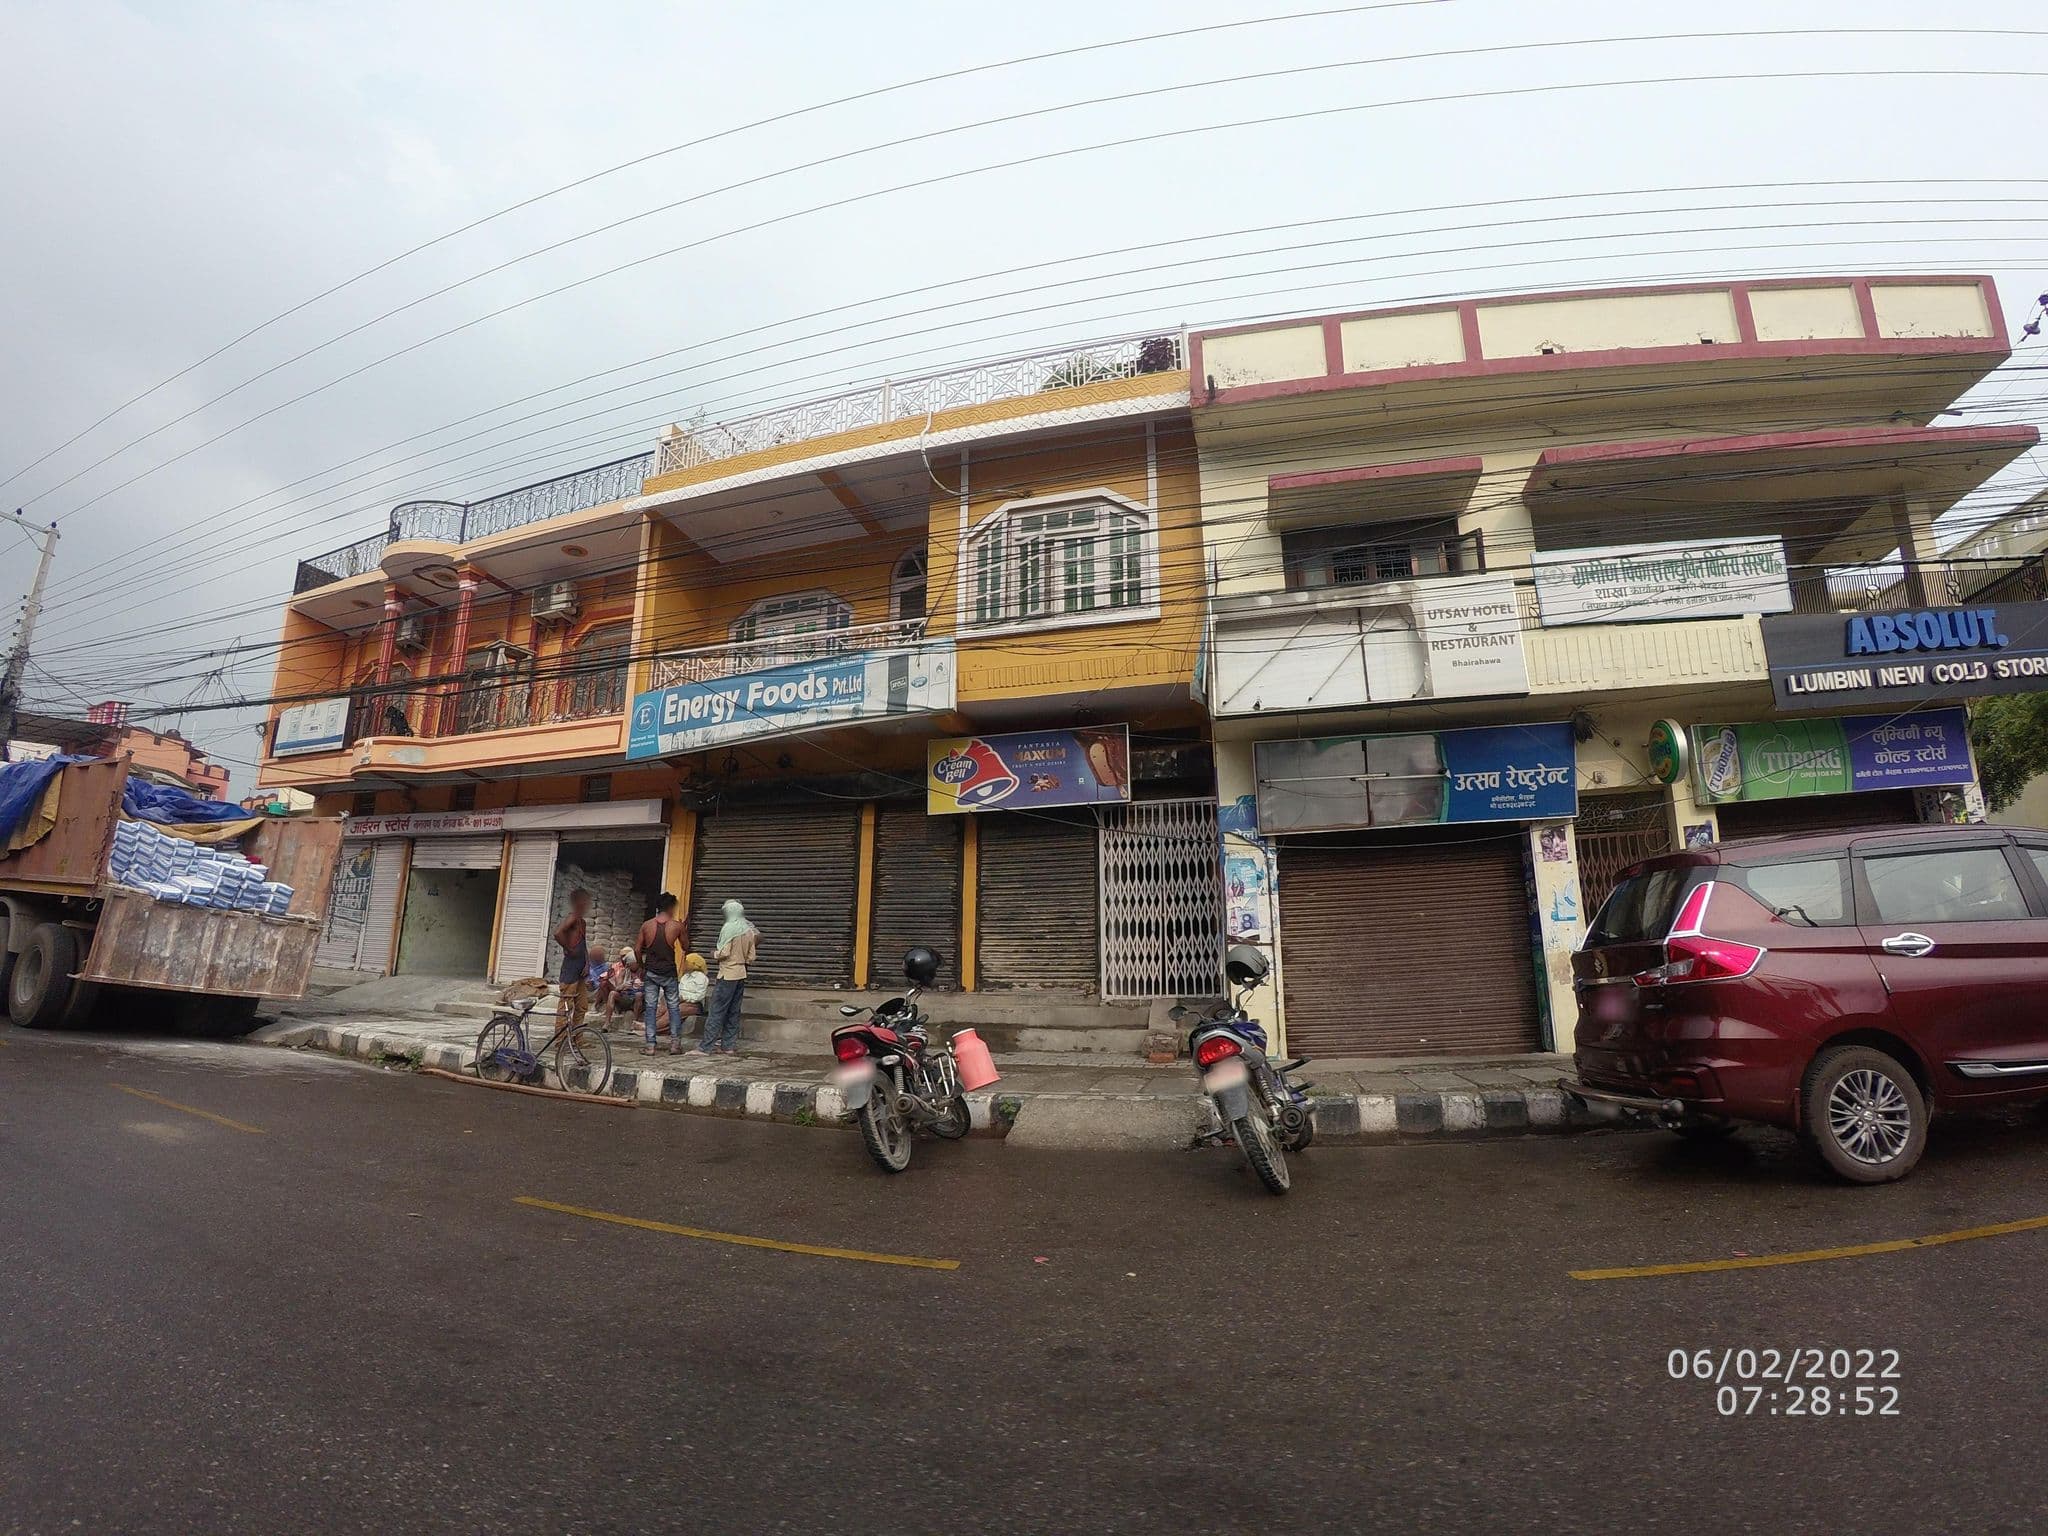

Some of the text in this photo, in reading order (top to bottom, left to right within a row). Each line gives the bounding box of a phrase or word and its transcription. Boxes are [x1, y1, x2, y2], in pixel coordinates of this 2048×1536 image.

[1427, 604, 1515, 620] UTSAV HOTEL
[1468, 622, 1478, 632] &
[1431, 634, 1516, 651] RESTAURANT
[1452, 658, 1501, 667] Bhairahawa
[1789, 668, 1872, 693] LUMBINI
[1878, 665, 1925, 687] NEW
[1932, 661, 1988, 683] COLD
[663, 689, 740, 724] Energy
[746, 673, 827, 711] Foods
[1872, 724, 1946, 746] लुम्बिनी न्यू
[1018, 741, 1061, 749] FANTASIA
[1761, 746, 1841, 774] TUBORG
[1874, 744, 1947, 764] कोल्ड स्टोर्स
[937, 760, 972, 774] Cream
[945, 768, 967, 783] Bell
[1454, 772, 1501, 791] उत्सव
